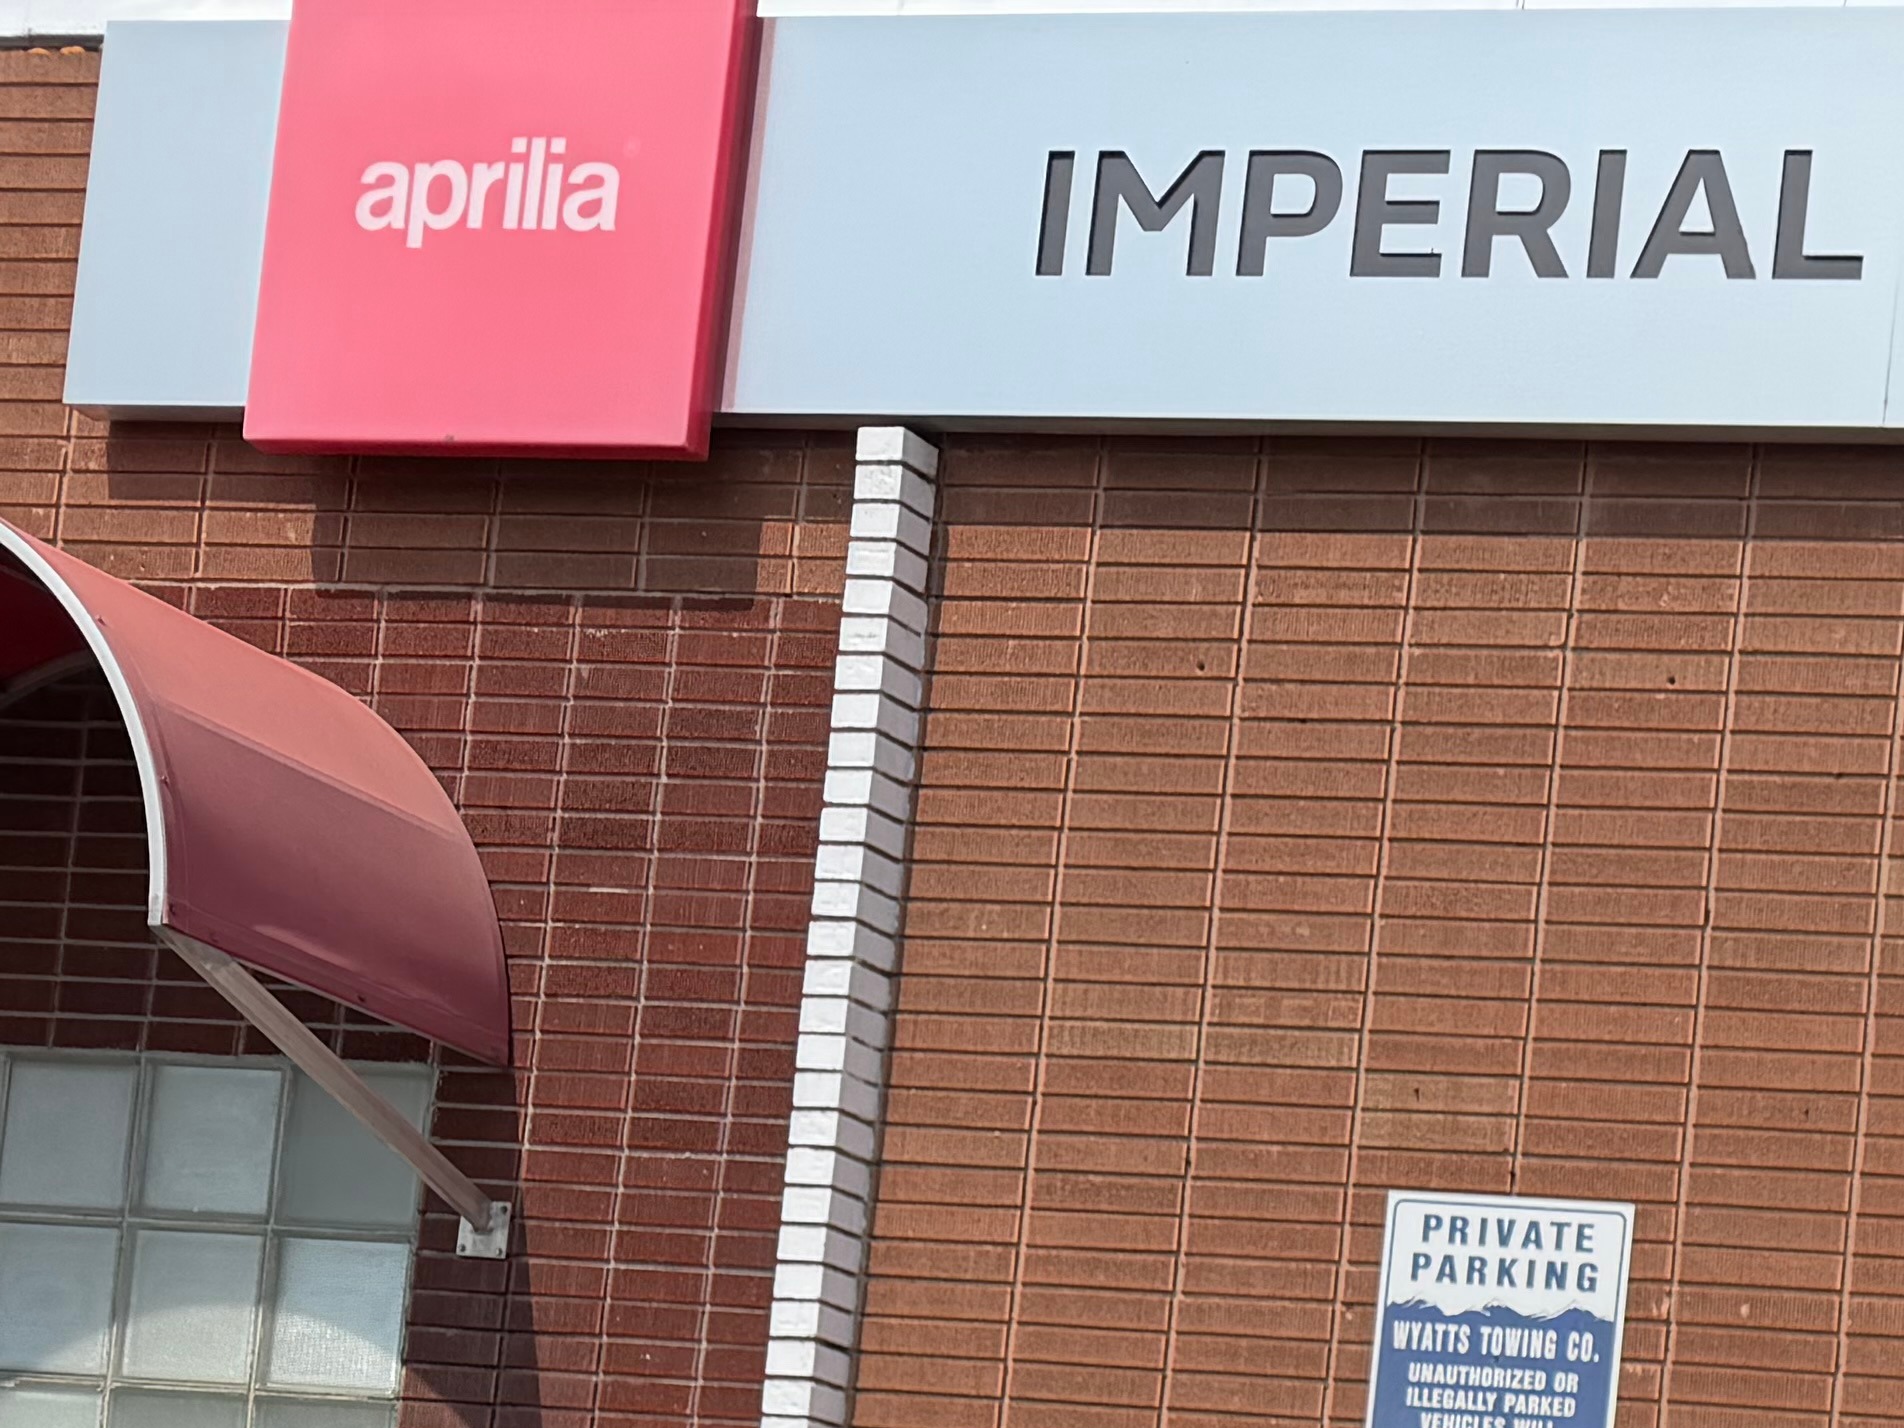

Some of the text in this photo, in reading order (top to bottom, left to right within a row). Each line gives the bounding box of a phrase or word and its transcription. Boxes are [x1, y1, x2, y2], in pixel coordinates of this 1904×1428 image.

[355, 136, 621, 249] aprilia
[1035, 148, 1864, 280] IMPERIAL
[1422, 1213, 1595, 1253] PRIVATE
[1410, 1252, 1599, 1293] PARKING
[1393, 1320, 1600, 1364] WYATTS TOWING CO.
[1408, 1362, 1579, 1394] UNAUTHORIZED OR
[1406, 1387, 1576, 1418] ILLEGALLY PARKED
